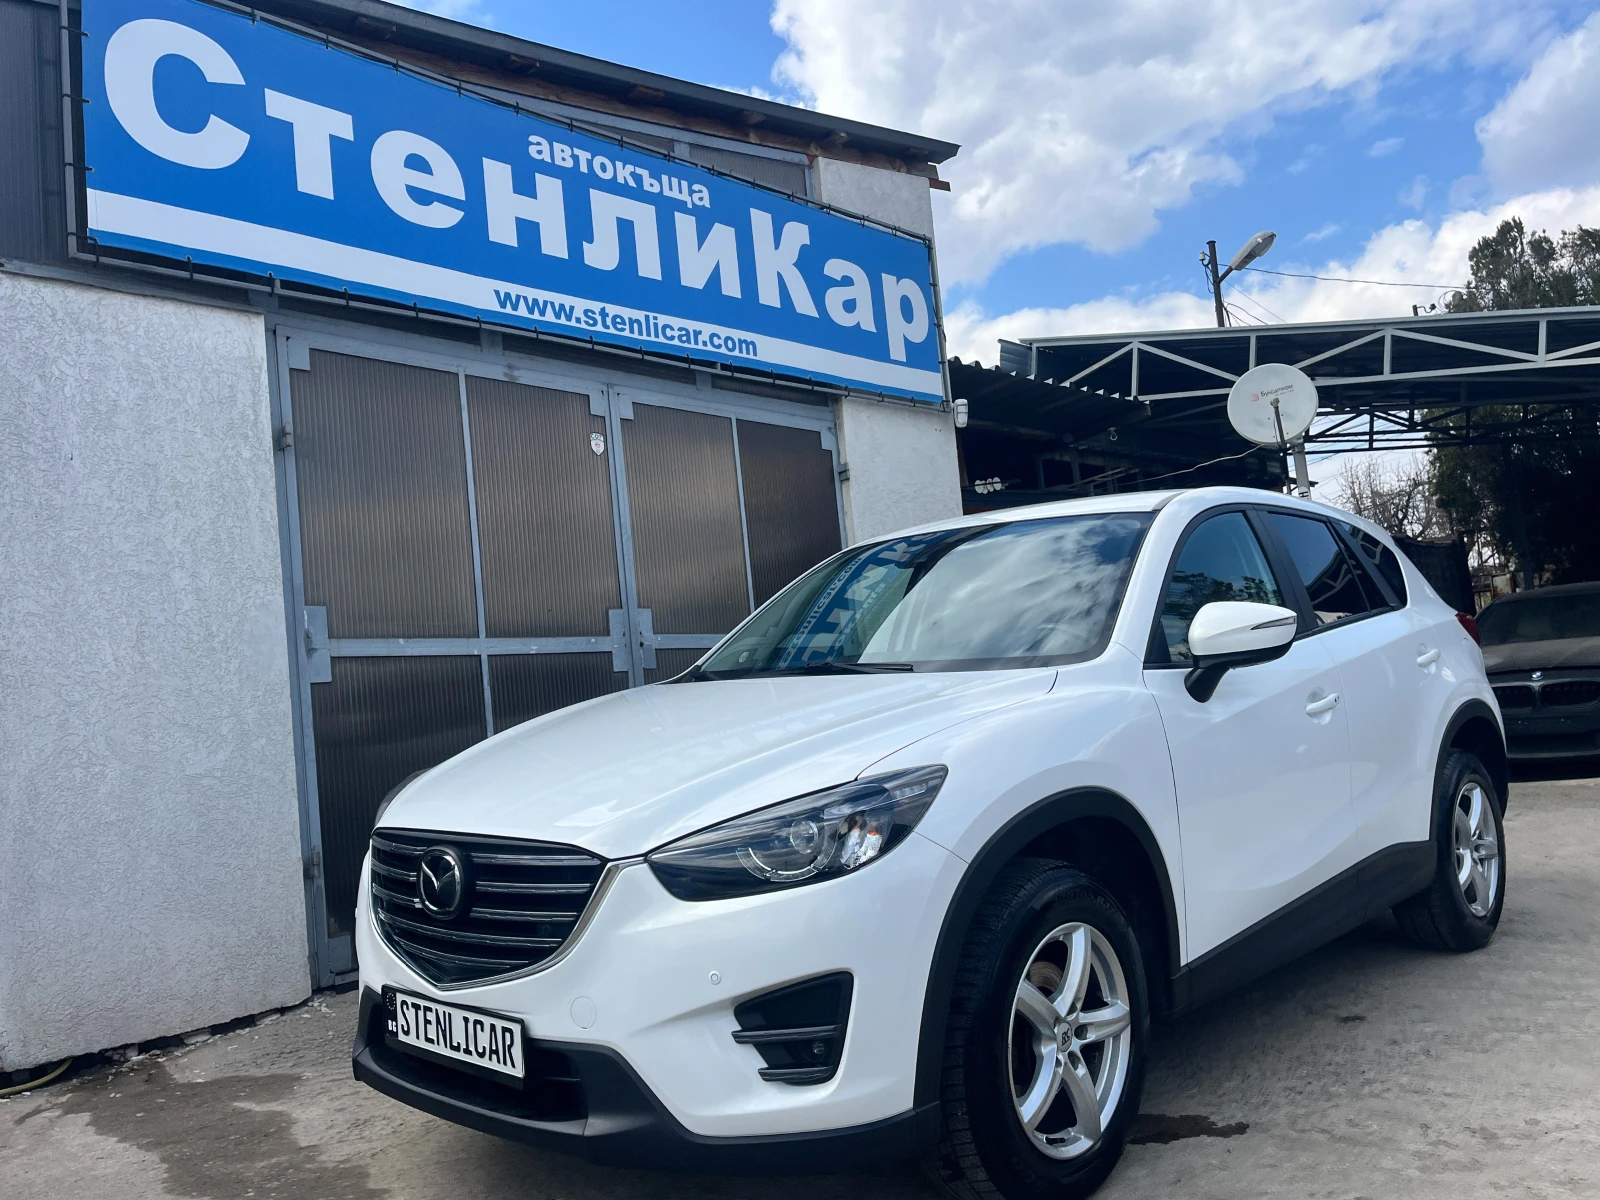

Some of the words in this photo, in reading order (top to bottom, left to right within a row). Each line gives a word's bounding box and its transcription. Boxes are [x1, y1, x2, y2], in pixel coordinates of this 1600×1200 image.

[104, 18, 929, 362] СтенлиКар
[528, 134, 711, 208] автокъща
[494, 288, 758, 358] www.stenlicar.com
[388, 1019, 397, 1033] BG
[400, 999, 516, 1069] STENLICAR
